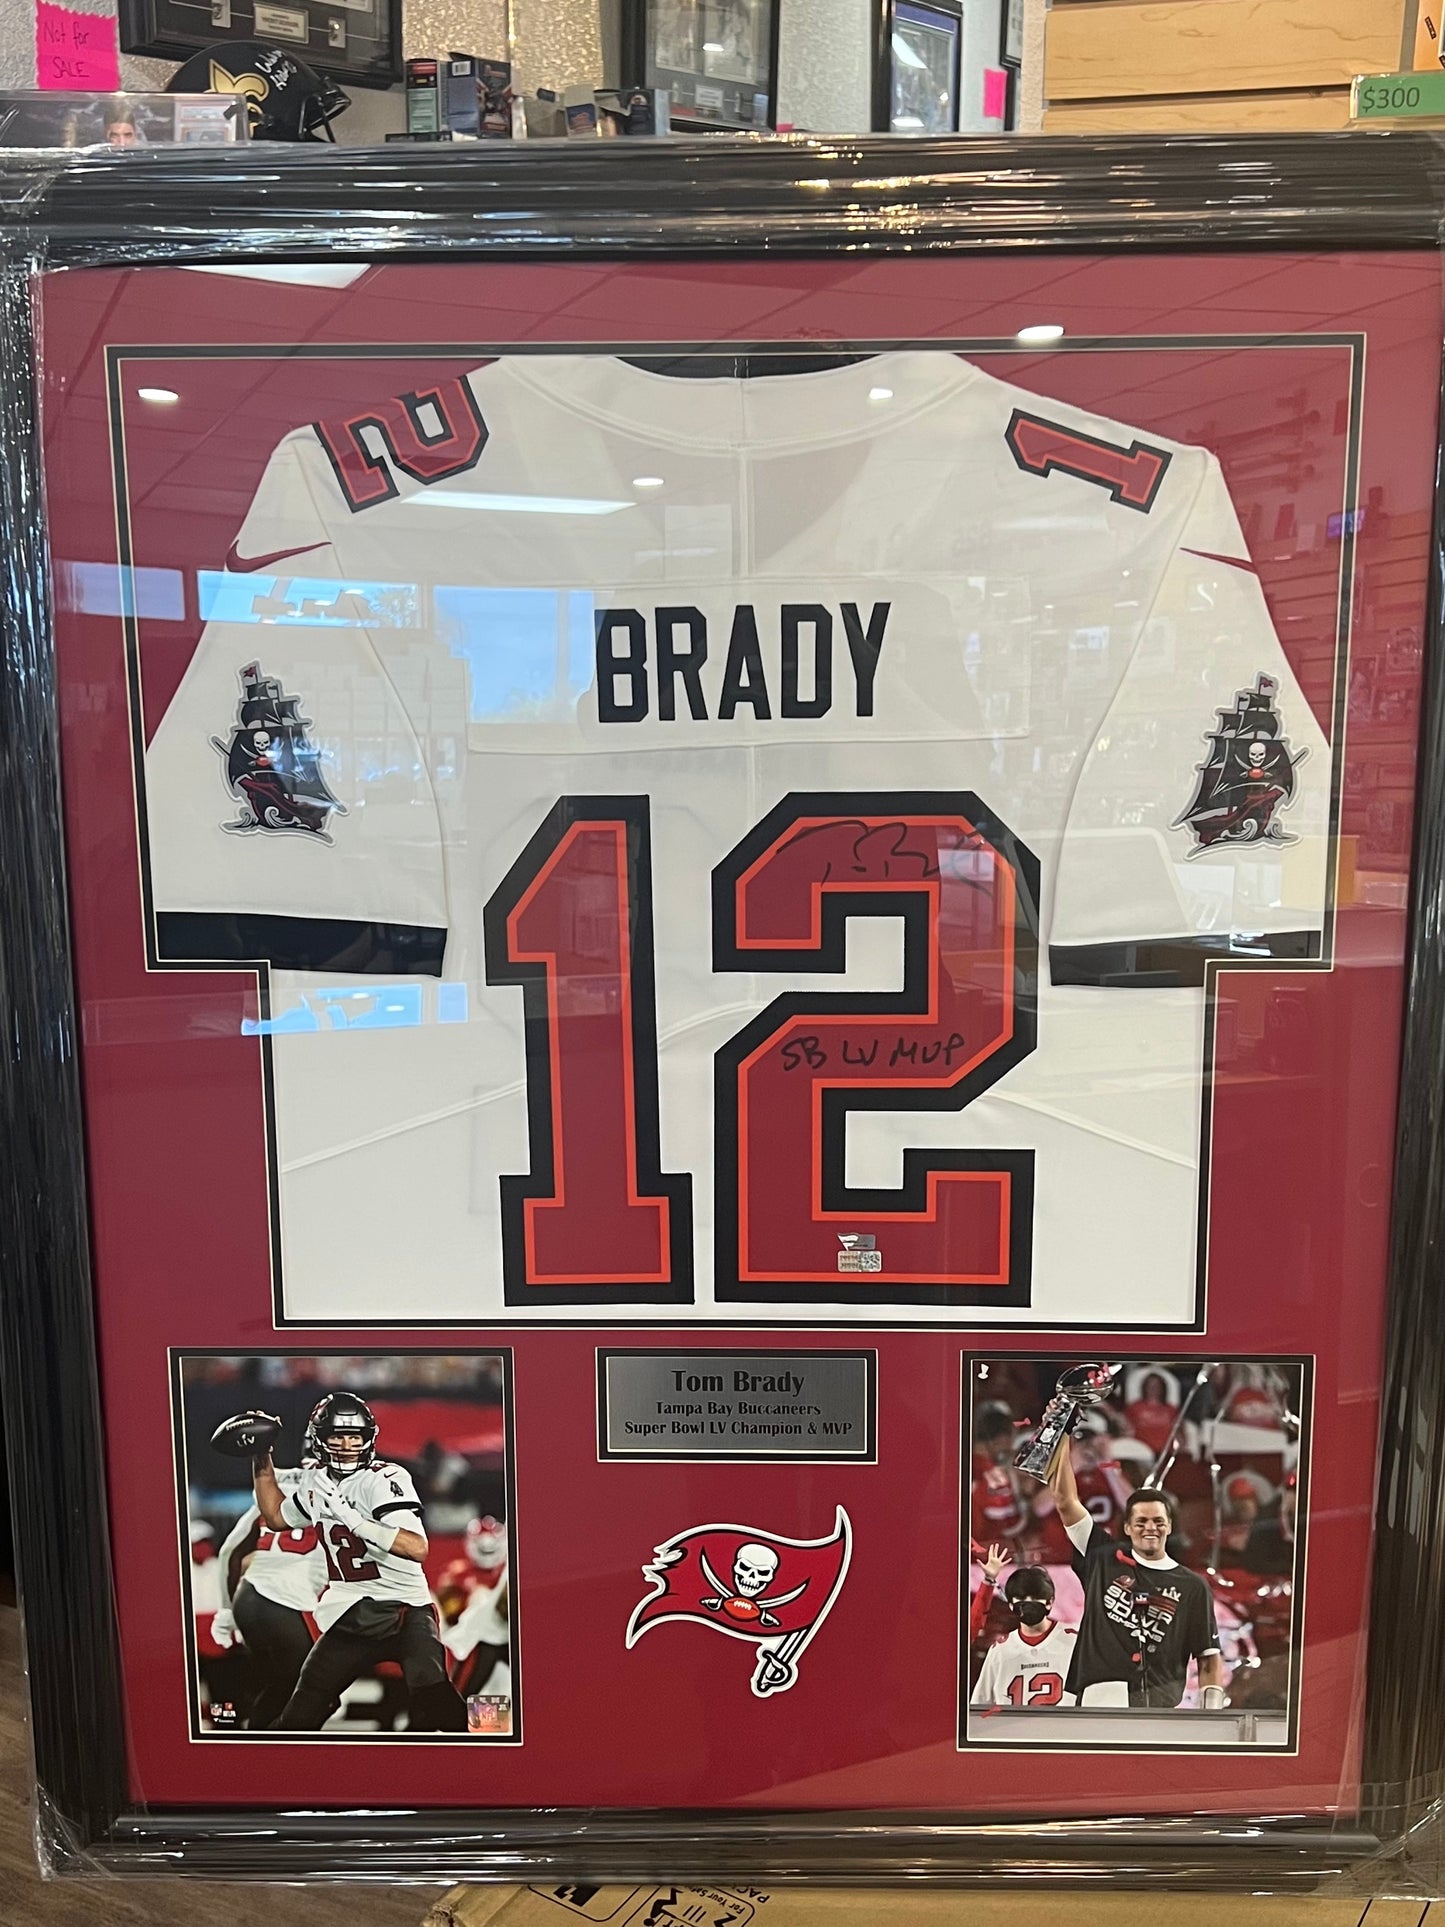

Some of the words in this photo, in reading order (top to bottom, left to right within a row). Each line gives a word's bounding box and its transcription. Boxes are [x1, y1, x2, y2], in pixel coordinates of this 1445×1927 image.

[43, 21, 66, 43] Not
[73, 21, 90, 50] for
[53, 56, 91, 79] SALE
[1361, 85, 1421, 113] $300
[1004, 408, 1173, 514] 1
[594, 602, 891, 723] BRADY
[483, 791, 1041, 1308] 12
[780, 1036, 828, 1071] SB
[843, 1039, 879, 1067] LV
[889, 1033, 965, 1067] MVP
[671, 1370, 724, 1393] Tom
[733, 1370, 805, 1397] Brady
[656, 1402, 703, 1417] Tampa
[707, 1402, 733, 1417] Bay
[738, 1402, 821, 1416] Buccaneers
[624, 1421, 667, 1437] Super
[671, 1421, 705, 1435] Bowl
[709, 1421, 727, 1435] LV
[731, 1421, 802, 1437] Champion
[807, 1421, 817, 1435] &
[822, 1421, 853, 1435] MVP
[314, 1521, 381, 1583] 12
[1106, 1585, 1173, 1625] SUER
[1006, 1672, 1064, 1706] 12
[707, 1892, 729, 1907] Your
[728, 1902, 746, 1915] For
[731, 1885, 771, 1904] PAC
